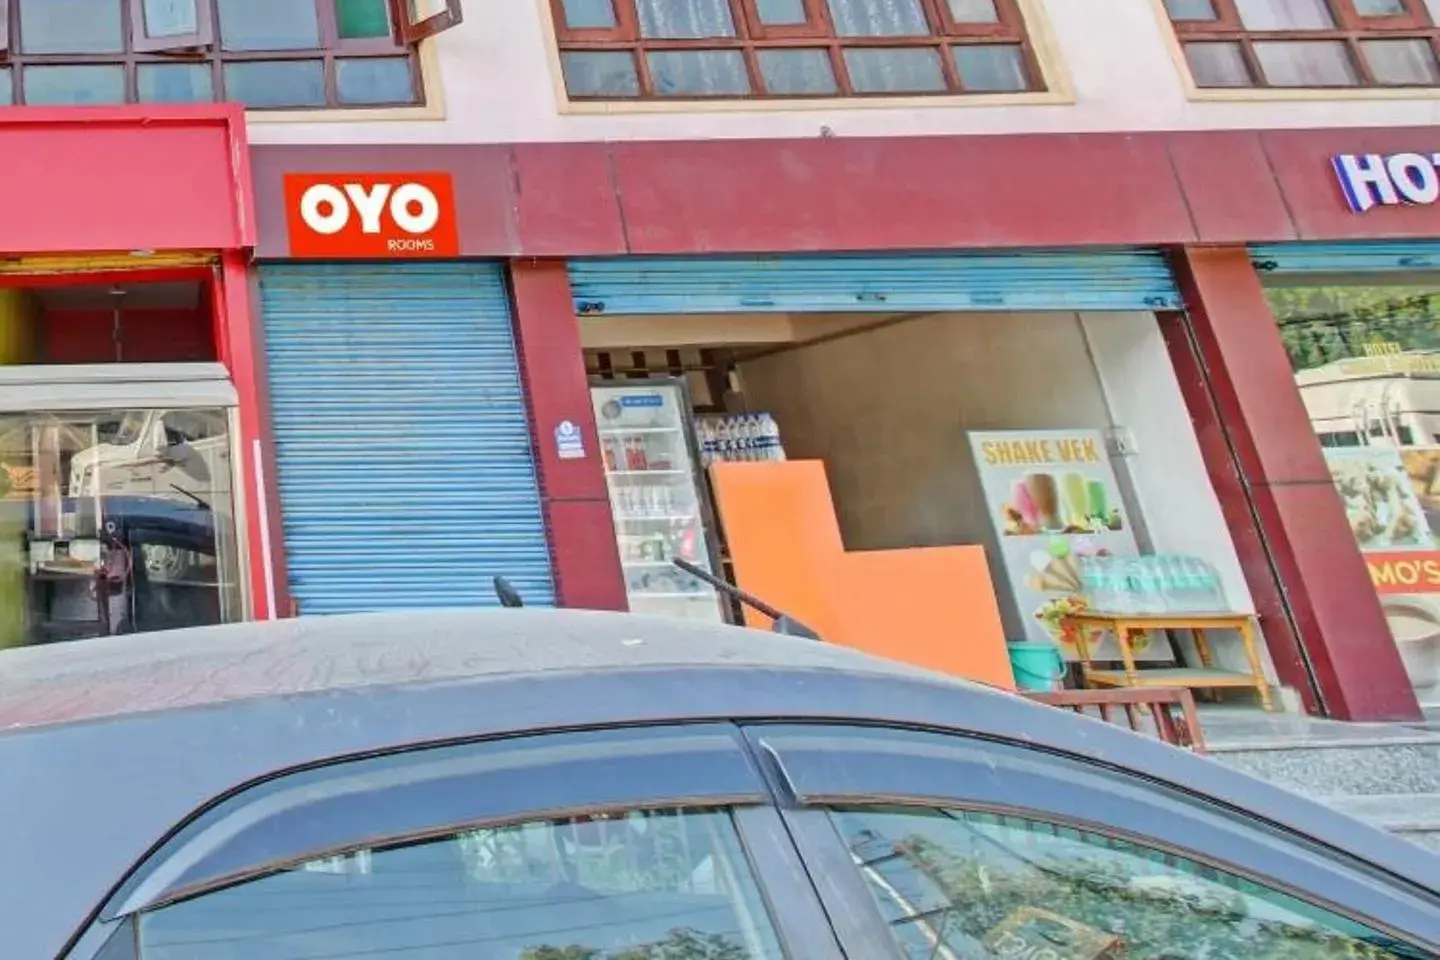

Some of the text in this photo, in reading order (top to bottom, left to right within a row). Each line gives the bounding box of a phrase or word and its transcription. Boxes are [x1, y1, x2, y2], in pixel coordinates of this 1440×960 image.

[1330, 152, 1440, 214] HO
[300, 182, 440, 235] OYO
[387, 239, 435, 251] ROOMS
[981, 439, 1054, 465] SHAKE
